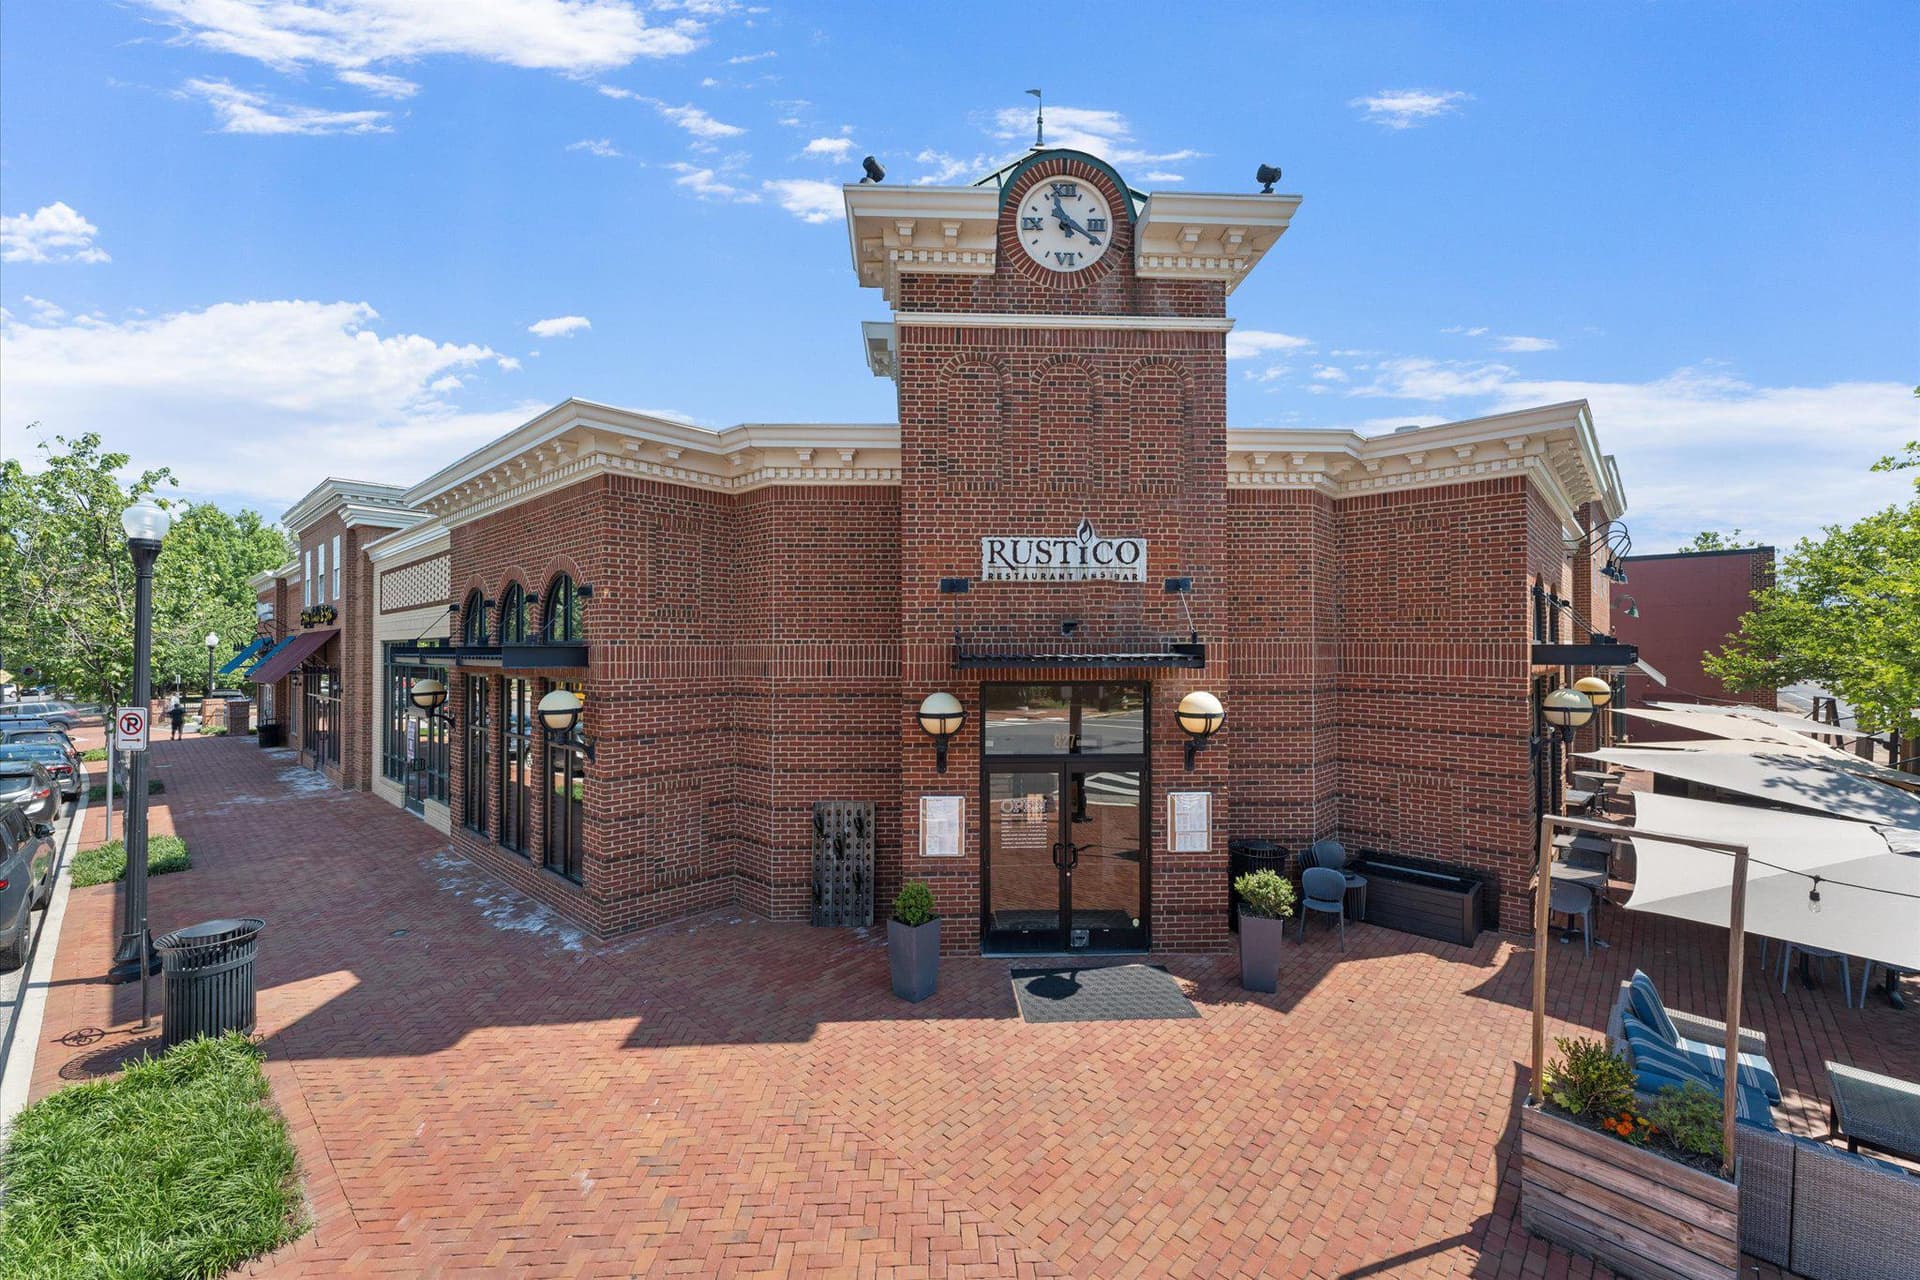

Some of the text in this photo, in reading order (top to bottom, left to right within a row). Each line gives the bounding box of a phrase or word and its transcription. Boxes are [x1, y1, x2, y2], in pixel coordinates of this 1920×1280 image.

[1050, 184, 1077, 197] XII
[1022, 217, 1043, 230] IX
[1087, 218, 1106, 232] III
[1054, 252, 1075, 266] VI
[988, 539, 1140, 570] RUSTICO
[988, 572, 1073, 580] RESTAURANT
[1114, 573, 1138, 581] BAR
[127, 717, 138, 731] P
